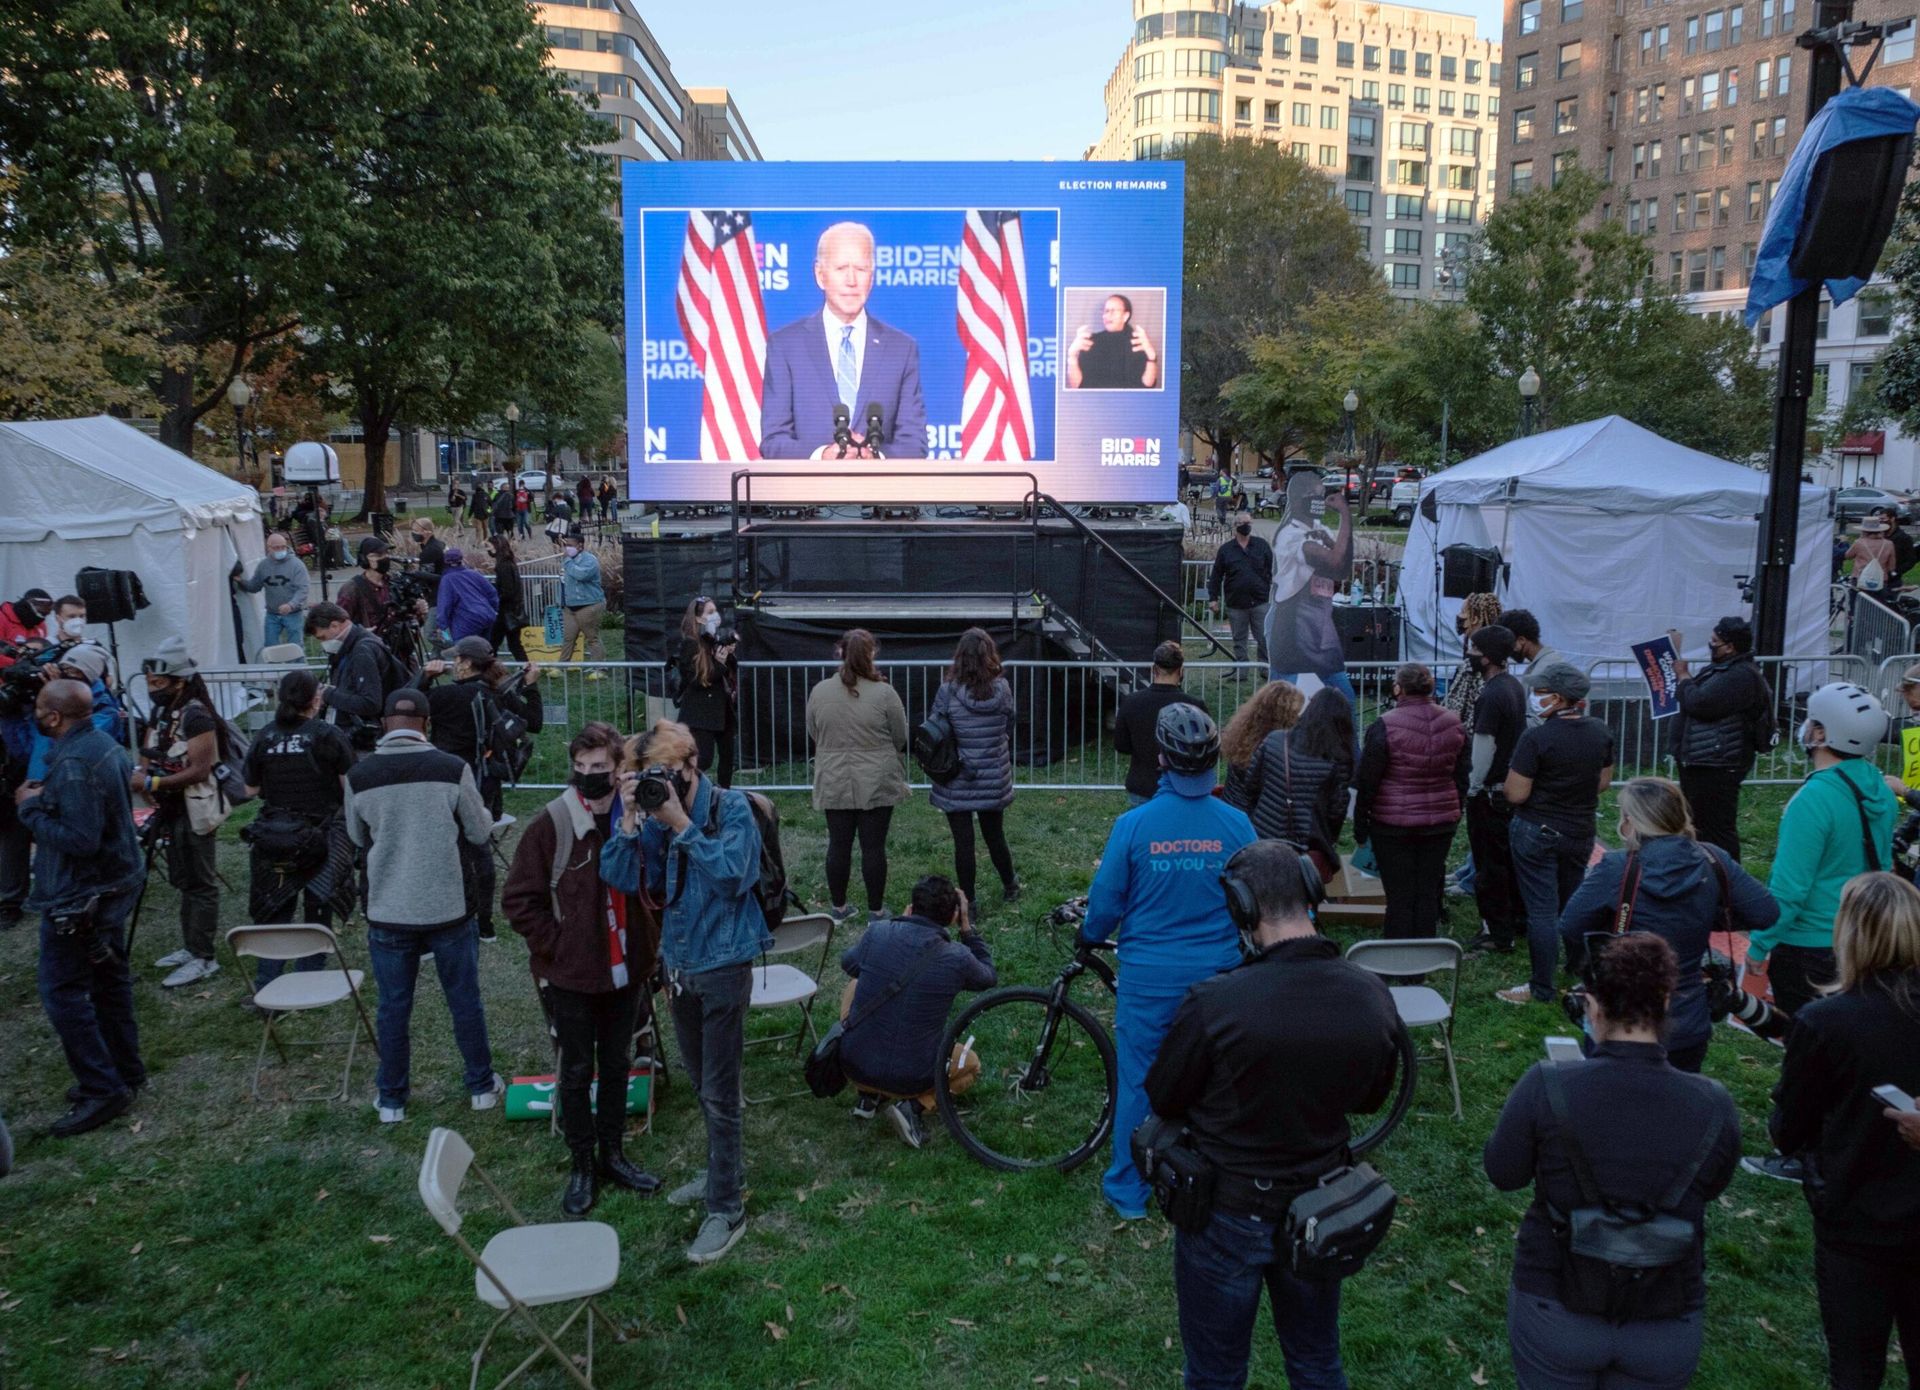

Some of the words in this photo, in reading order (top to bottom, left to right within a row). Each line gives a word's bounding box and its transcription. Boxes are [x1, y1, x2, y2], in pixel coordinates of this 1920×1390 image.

[1059, 180, 1112, 190] ELECTION
[1115, 180, 1167, 190] REMARKS
[876, 244, 961, 267] BIDEN
[876, 267, 960, 286] HARRIS
[1101, 438, 1160, 453] BIDEN
[1101, 453, 1160, 466] HARRIS
[1150, 839, 1223, 854] DOCTORS
[1150, 859, 1170, 872] TO
[1174, 857, 1205, 872] YOU
